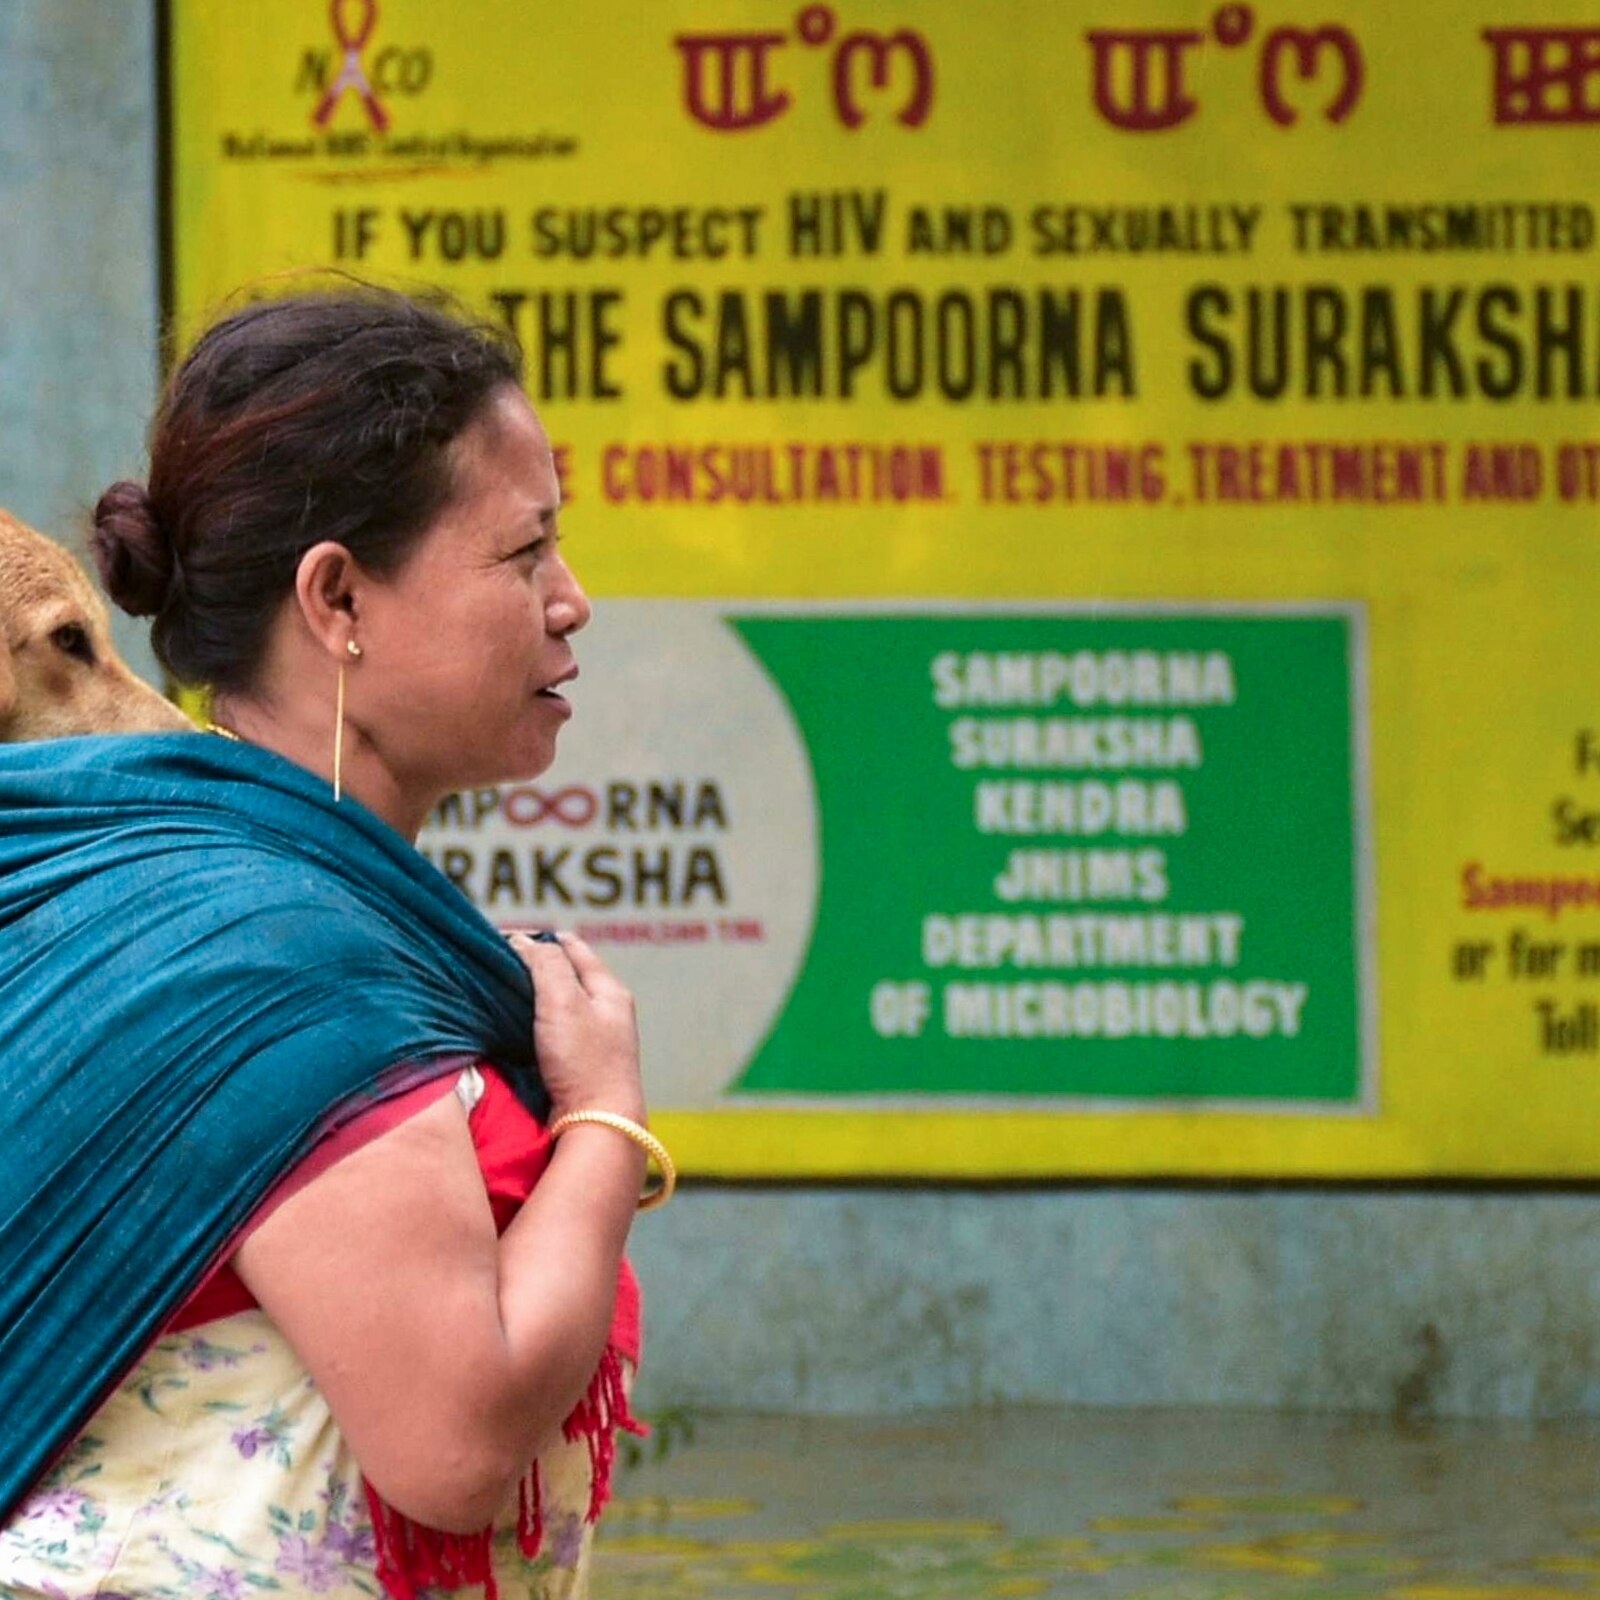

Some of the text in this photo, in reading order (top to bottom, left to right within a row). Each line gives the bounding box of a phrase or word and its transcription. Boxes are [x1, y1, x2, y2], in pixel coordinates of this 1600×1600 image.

[332, 207, 379, 261] IF
[400, 208, 508, 263] YOU
[531, 206, 764, 262] SUSPECT
[788, 190, 886, 257] HIV
[908, 206, 1013, 257] AND
[1029, 204, 1262, 258] SEXUALLY
[1290, 203, 1594, 253] TRANSMITTED
[491, 288, 623, 403] THE
[662, 285, 1137, 404] SAMPOORNA
[1461, 443, 1544, 503] AND
[931, 651, 1234, 706] SAMPOORNA
[950, 717, 1200, 768] SURAKSHA
[975, 779, 1186, 835] KENDRA
[442, 846, 728, 907] RAKSHA
[995, 849, 1168, 901] JNIMS
[922, 913, 1242, 968] DEPARTMENT
[1451, 941, 1495, 982] or
[1507, 930, 1566, 980] for
[870, 980, 1307, 1038] OF MICROBIOLOGY
